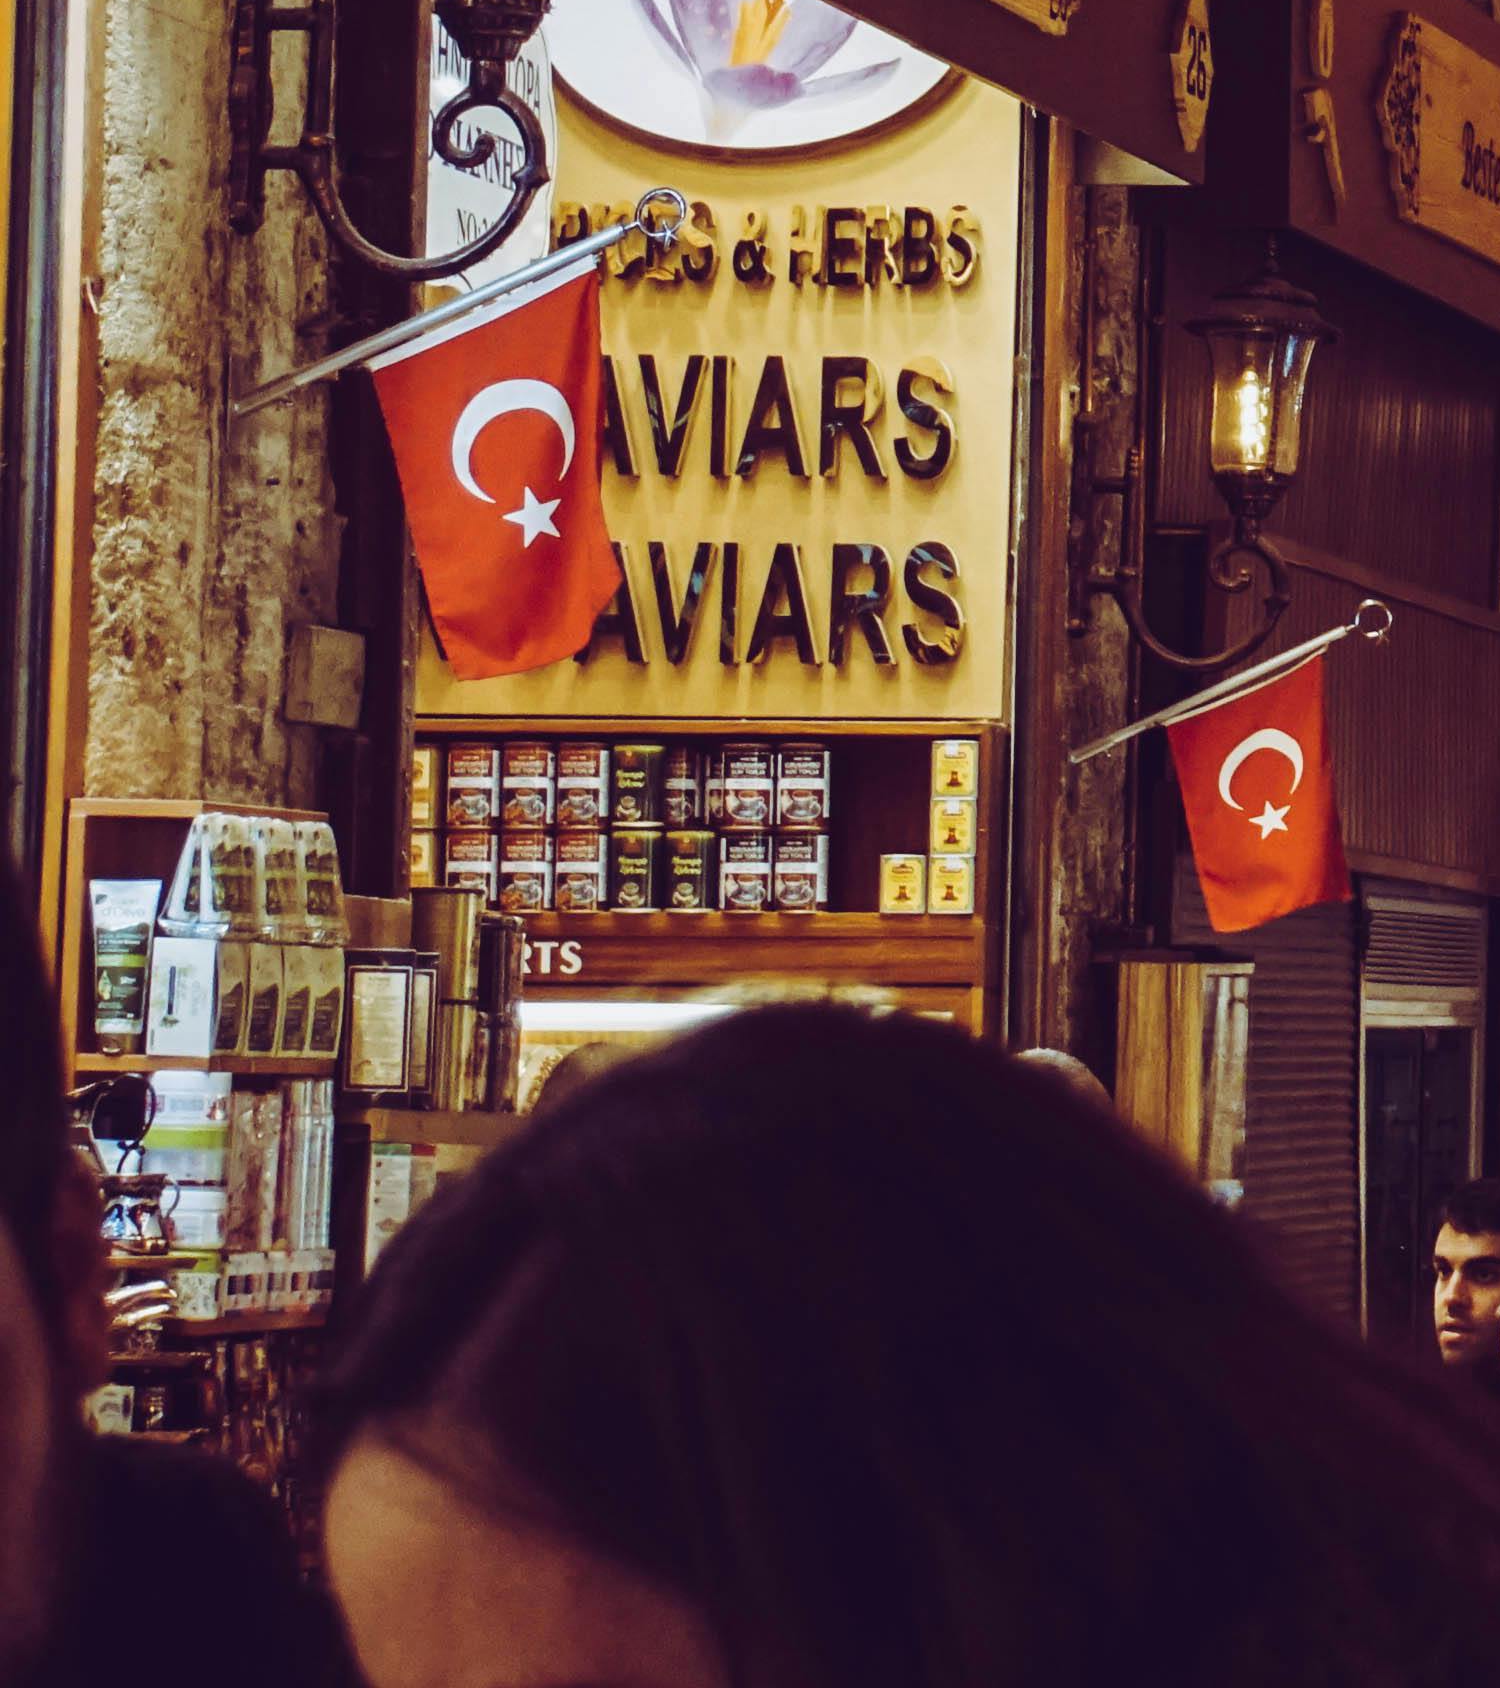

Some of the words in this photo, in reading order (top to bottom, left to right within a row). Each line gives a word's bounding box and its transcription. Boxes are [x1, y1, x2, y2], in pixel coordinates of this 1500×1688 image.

[1186, 24, 1207, 101] 26
[733, 212, 775, 283] &
[790, 204, 982, 287] HERBS
[601, 354, 958, 481] AVIARS
[573, 540, 966, 665] AVIARS
[520, 940, 583, 975] RTS
